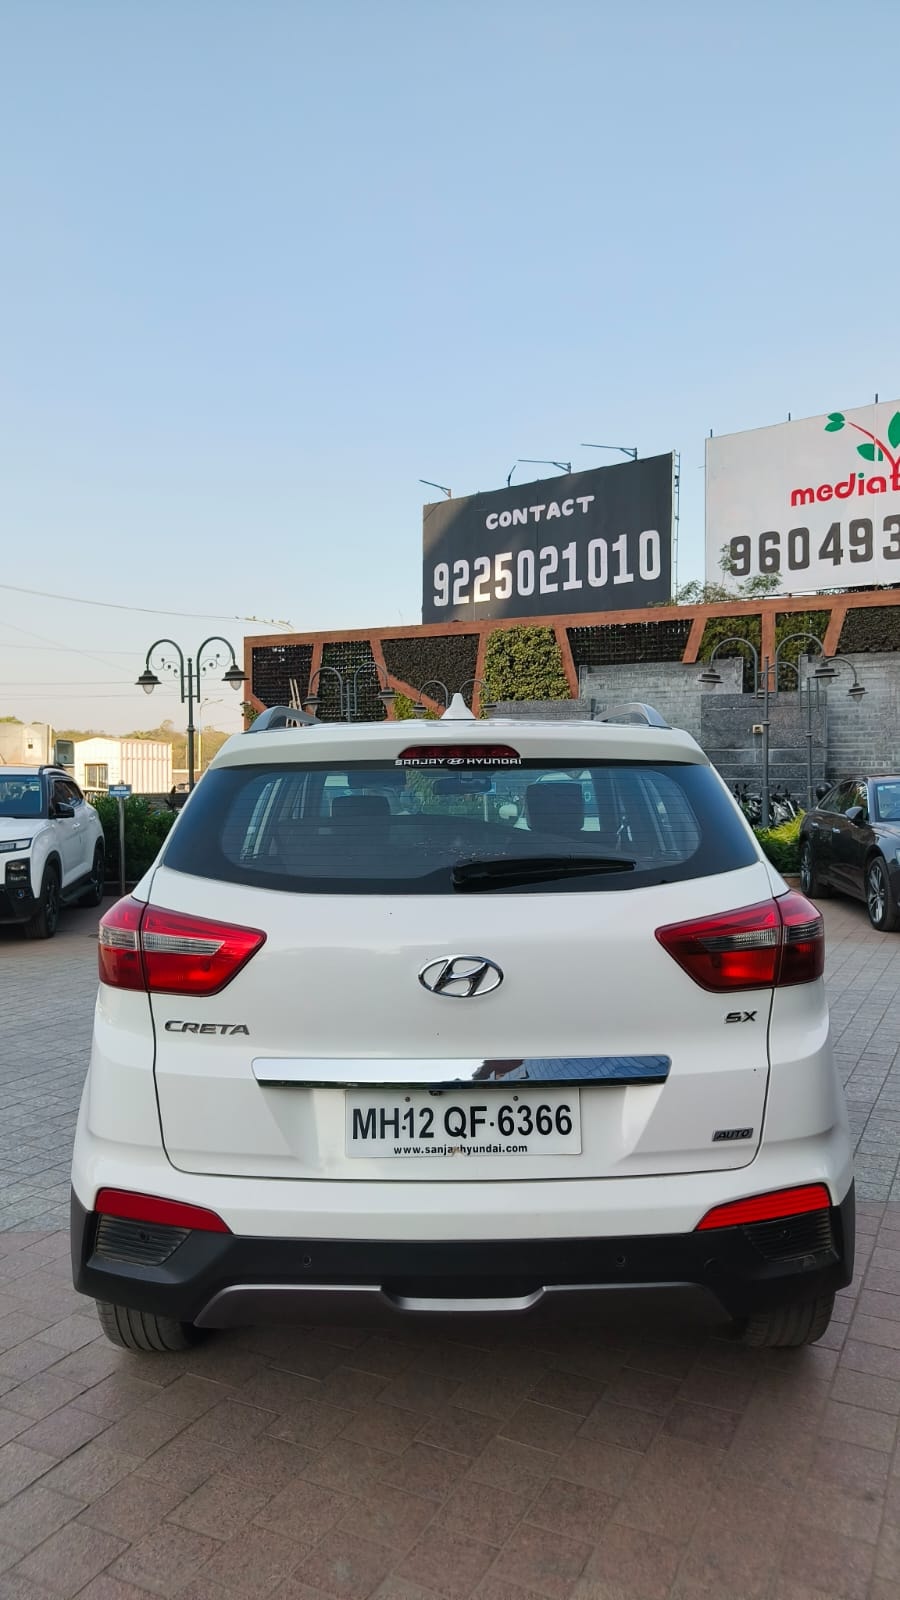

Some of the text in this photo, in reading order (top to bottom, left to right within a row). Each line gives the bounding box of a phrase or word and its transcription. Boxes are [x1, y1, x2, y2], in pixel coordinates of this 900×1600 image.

[485, 495, 595, 530] CONTACT
[433, 529, 662, 607] 9225021010
[394, 757, 522, 766] SANJAY HYUNDAI
[725, 1010, 758, 1024] SX
[164, 1020, 250, 1035] CRETA
[716, 1128, 750, 1140] AUTO
